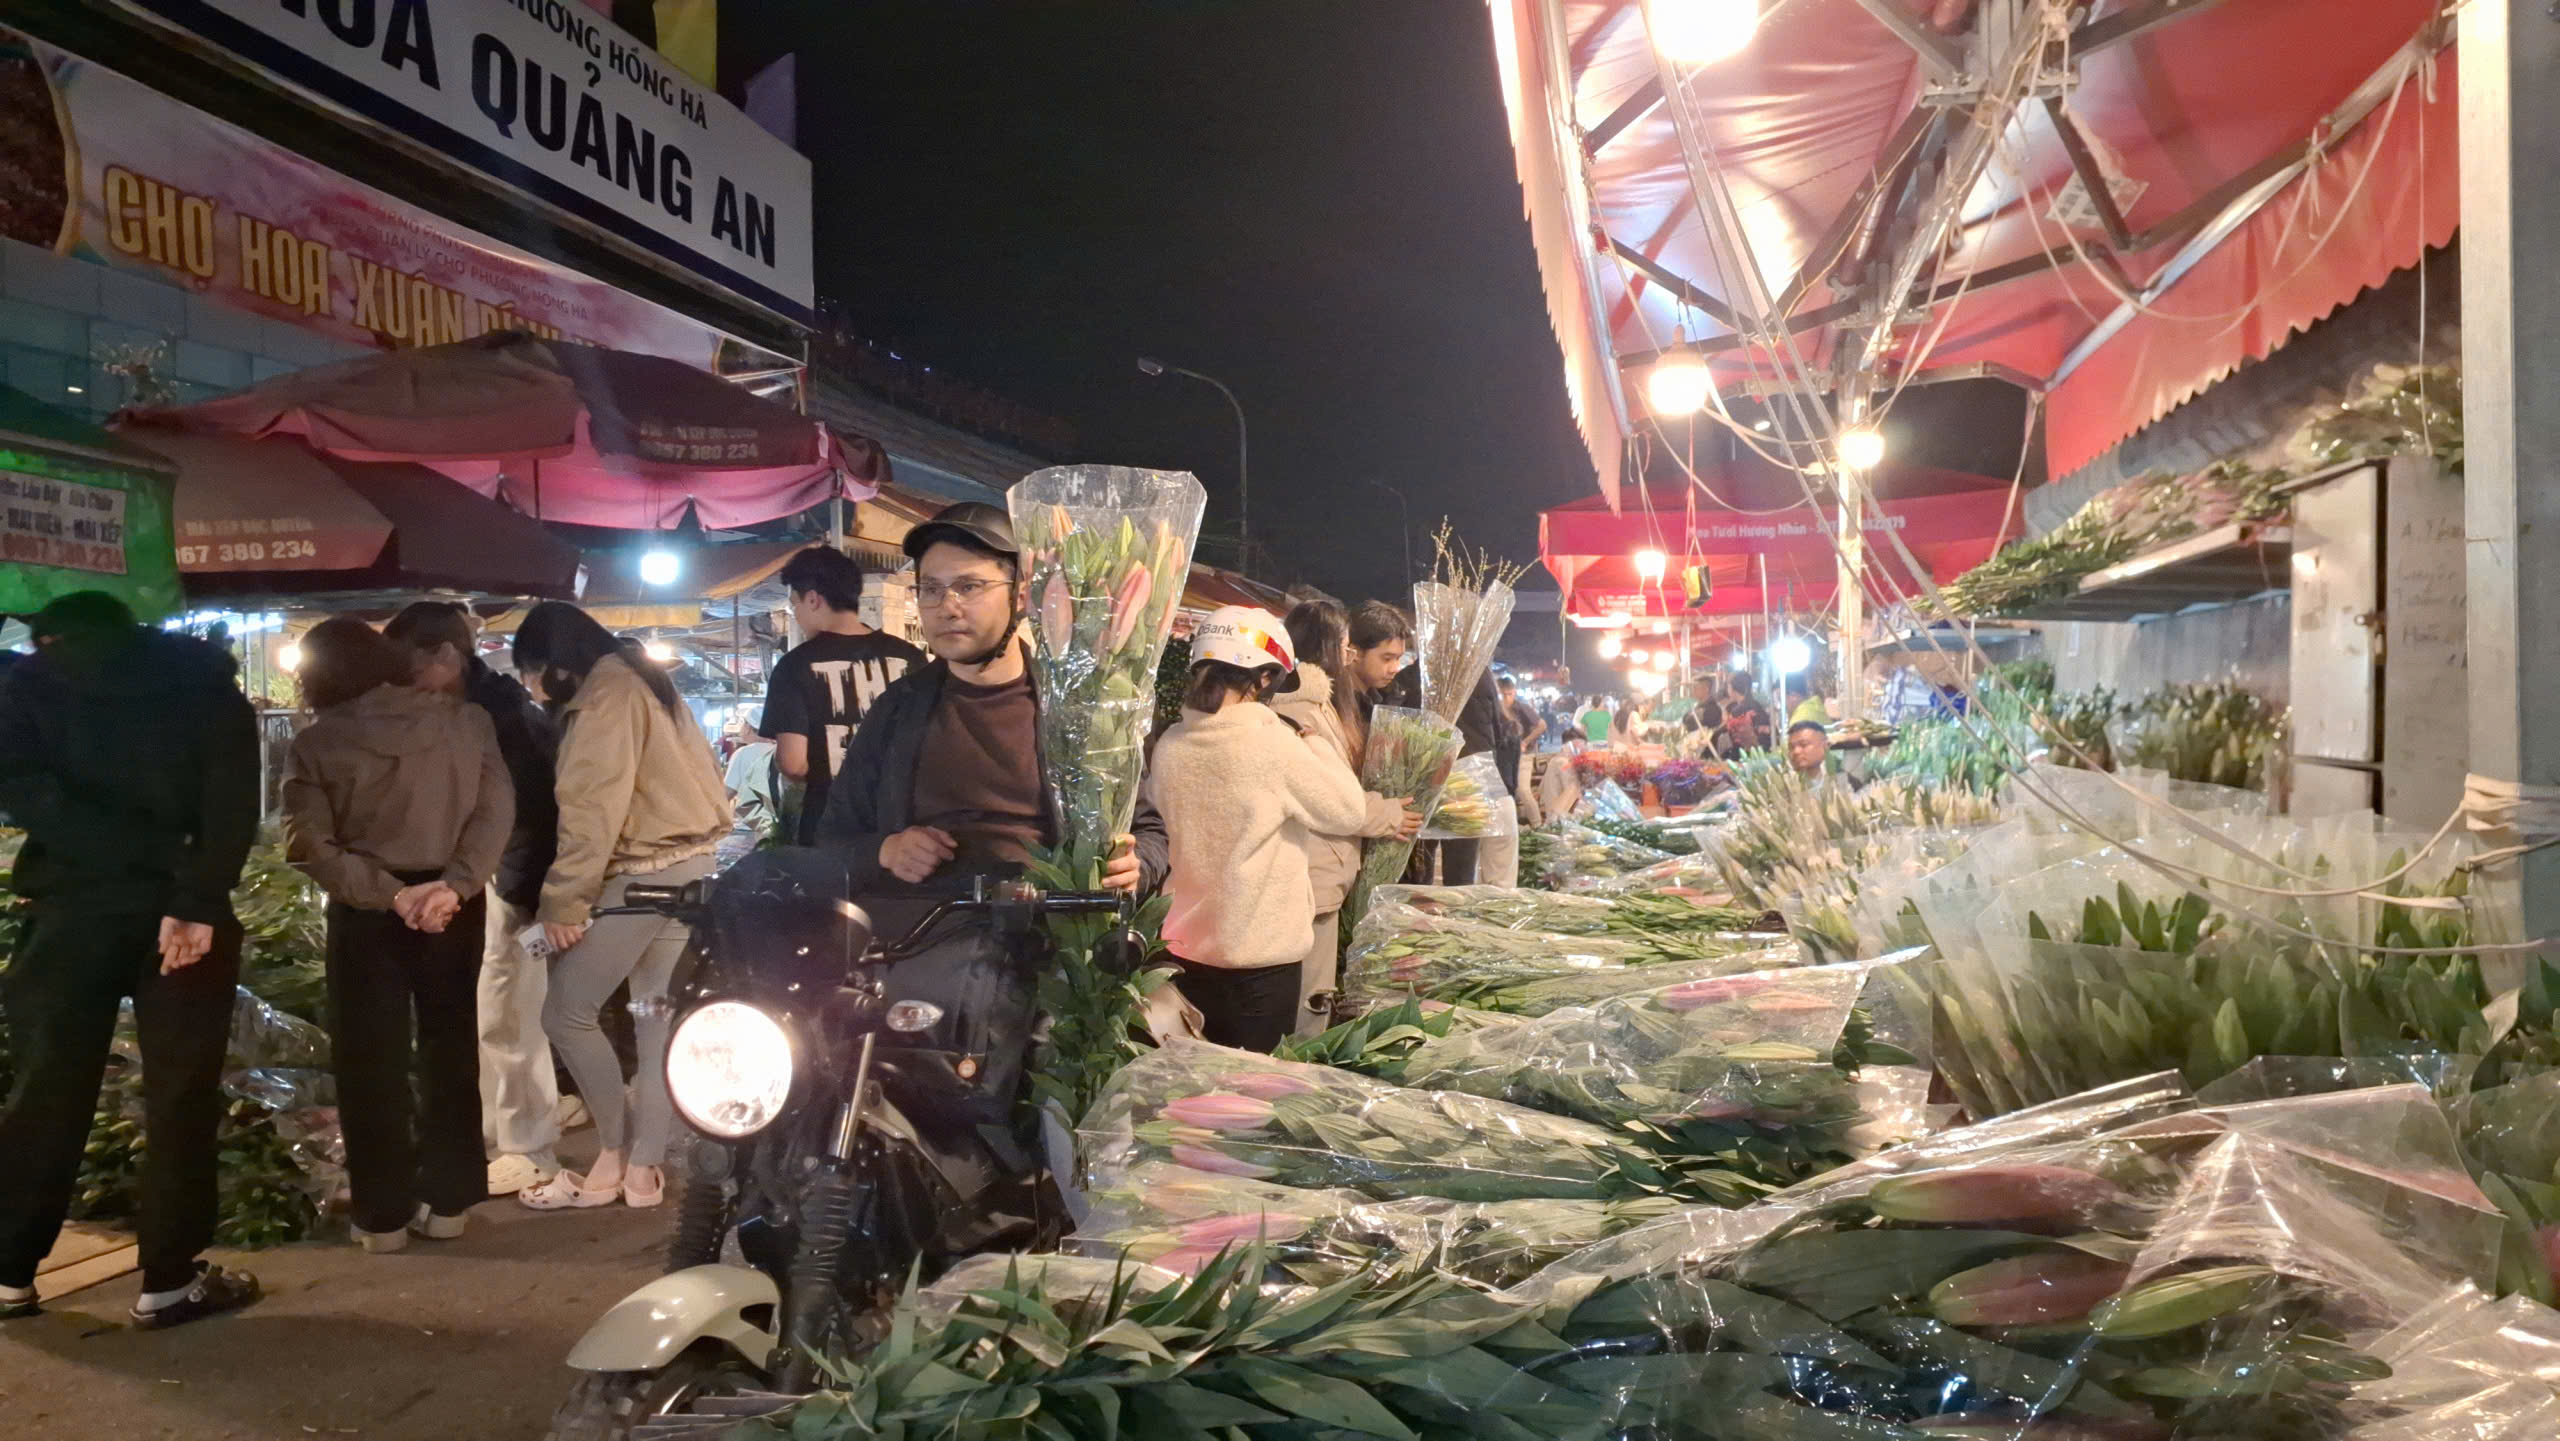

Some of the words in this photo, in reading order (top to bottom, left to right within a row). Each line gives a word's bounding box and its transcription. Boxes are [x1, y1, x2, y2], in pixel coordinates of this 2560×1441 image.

[281, 0, 440, 91] OA
[472, 33, 692, 224] QUẢNG
[711, 175, 775, 269] AN
[681, 87, 707, 130] HÀ
[105, 165, 216, 289] CHỢ
[236, 212, 331, 317] HOA
[349, 252, 465, 348] XUÂN
[218, 542, 264, 562] 380
[272, 540, 316, 559] 234
